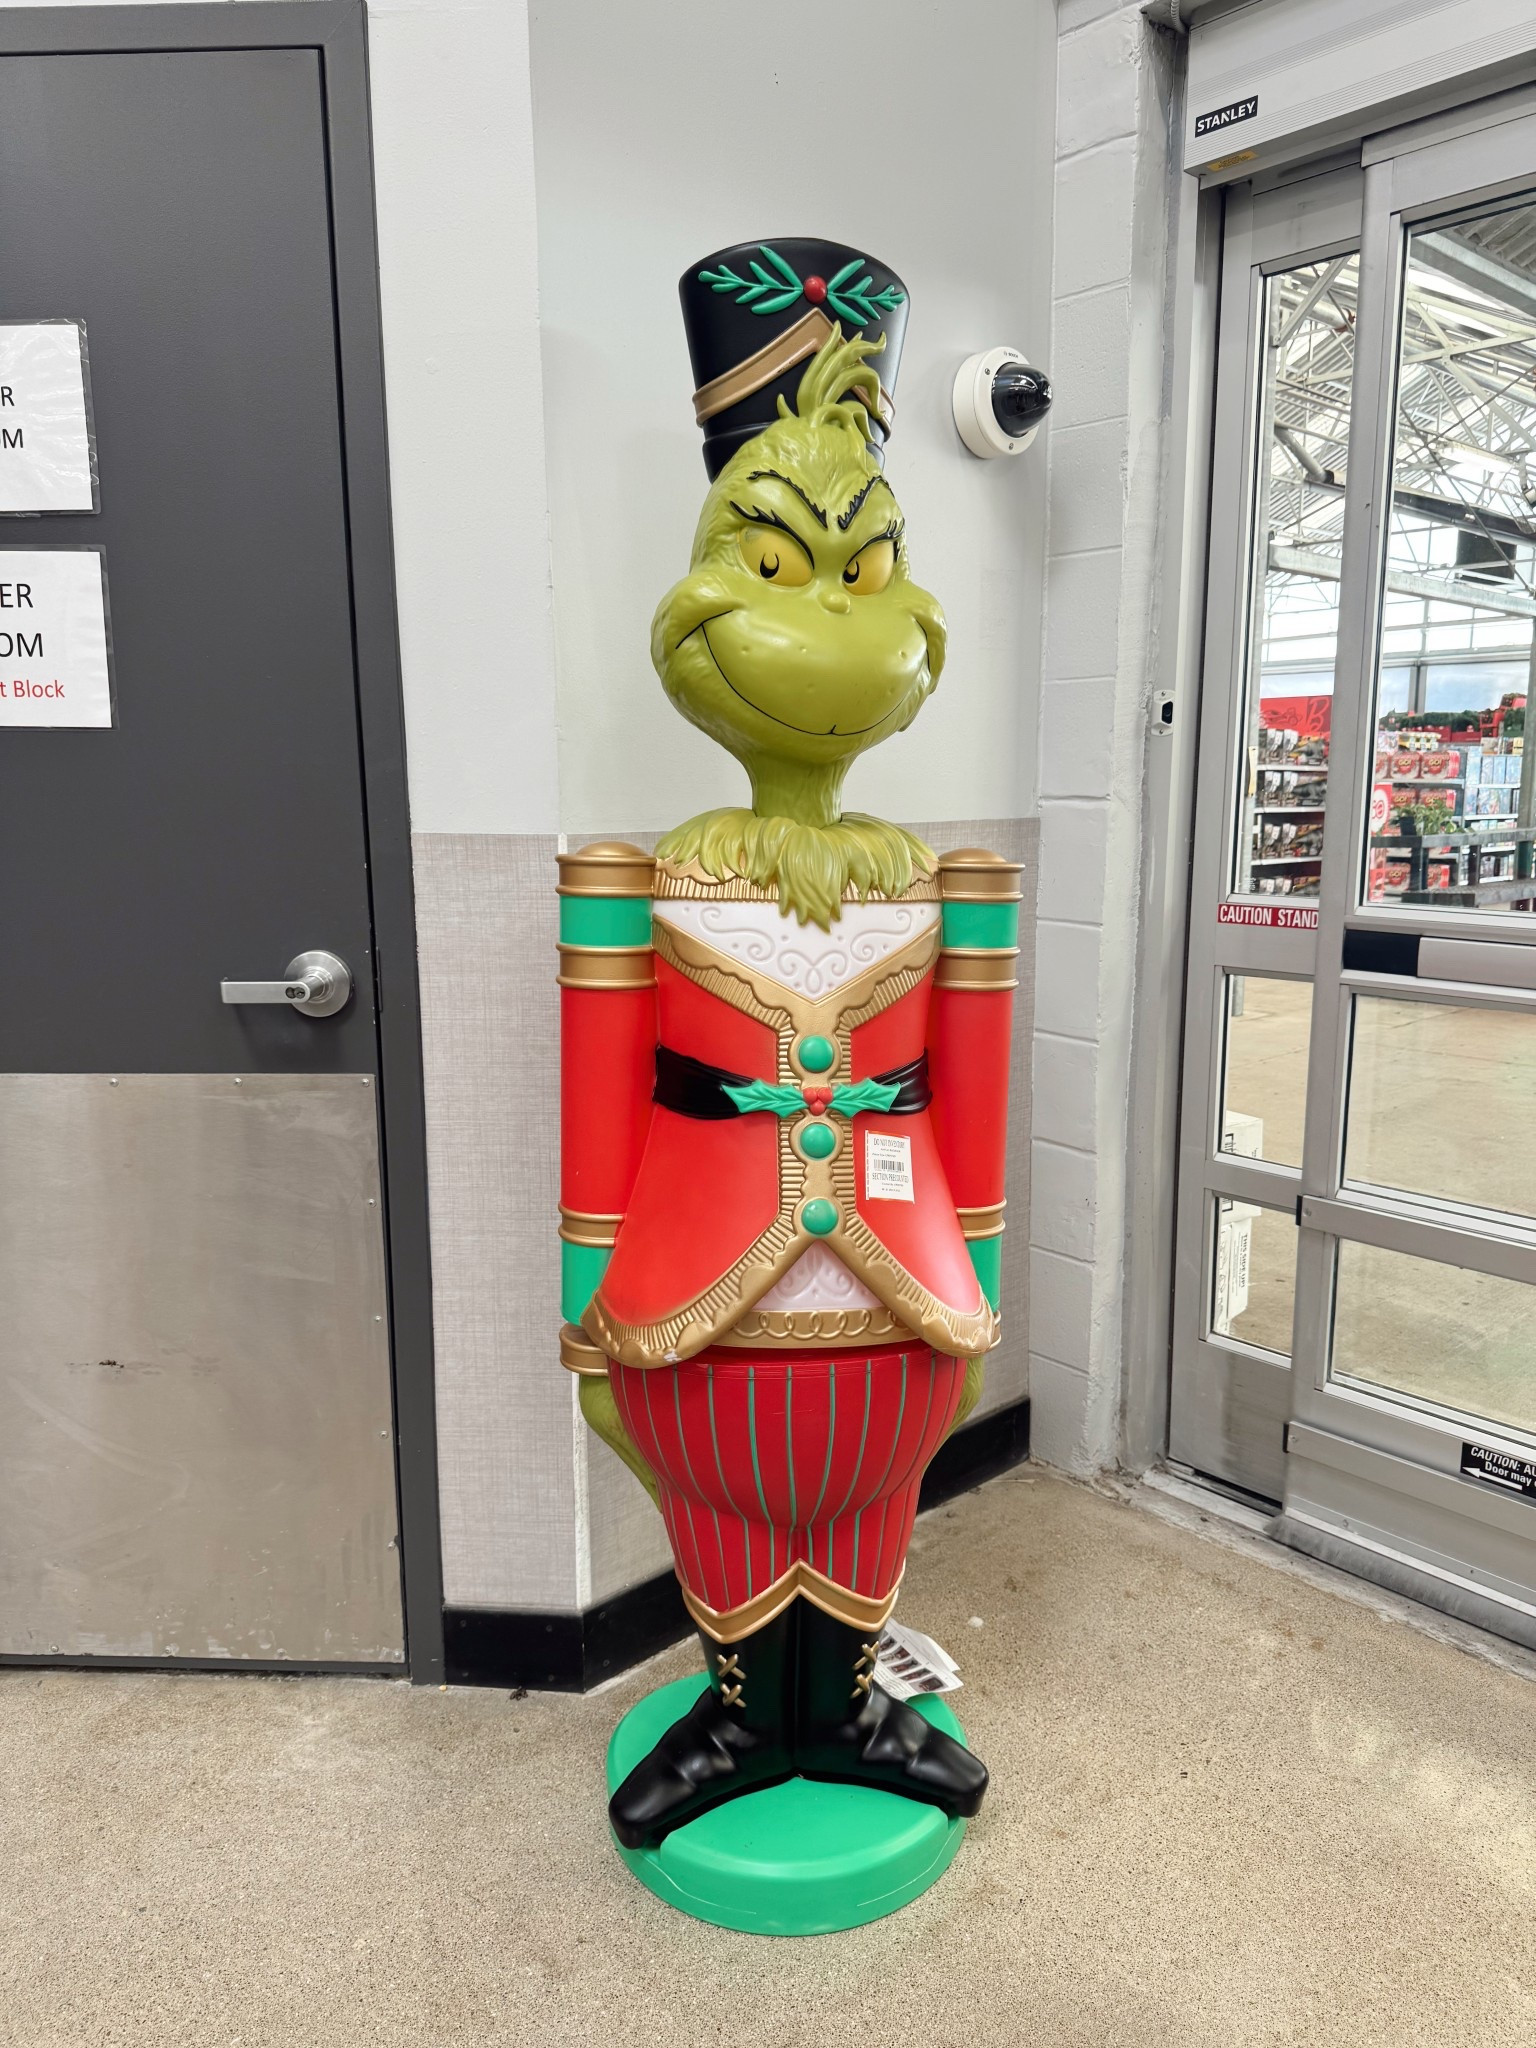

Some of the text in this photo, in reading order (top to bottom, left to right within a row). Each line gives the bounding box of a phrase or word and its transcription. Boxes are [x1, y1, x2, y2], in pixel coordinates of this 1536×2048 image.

[1197, 101, 1256, 132] STANLEY
[0, 428, 23, 449] M
[0, 583, 33, 608] ER
[0, 633, 43, 658] OM
[13, 680, 65, 698] Block
[1219, 905, 1319, 928] CAUTION STAND
[1471, 1447, 1521, 1471] CAUTION:
[1485, 1461, 1509, 1477] Door
[1511, 1473, 1532, 1487] may
